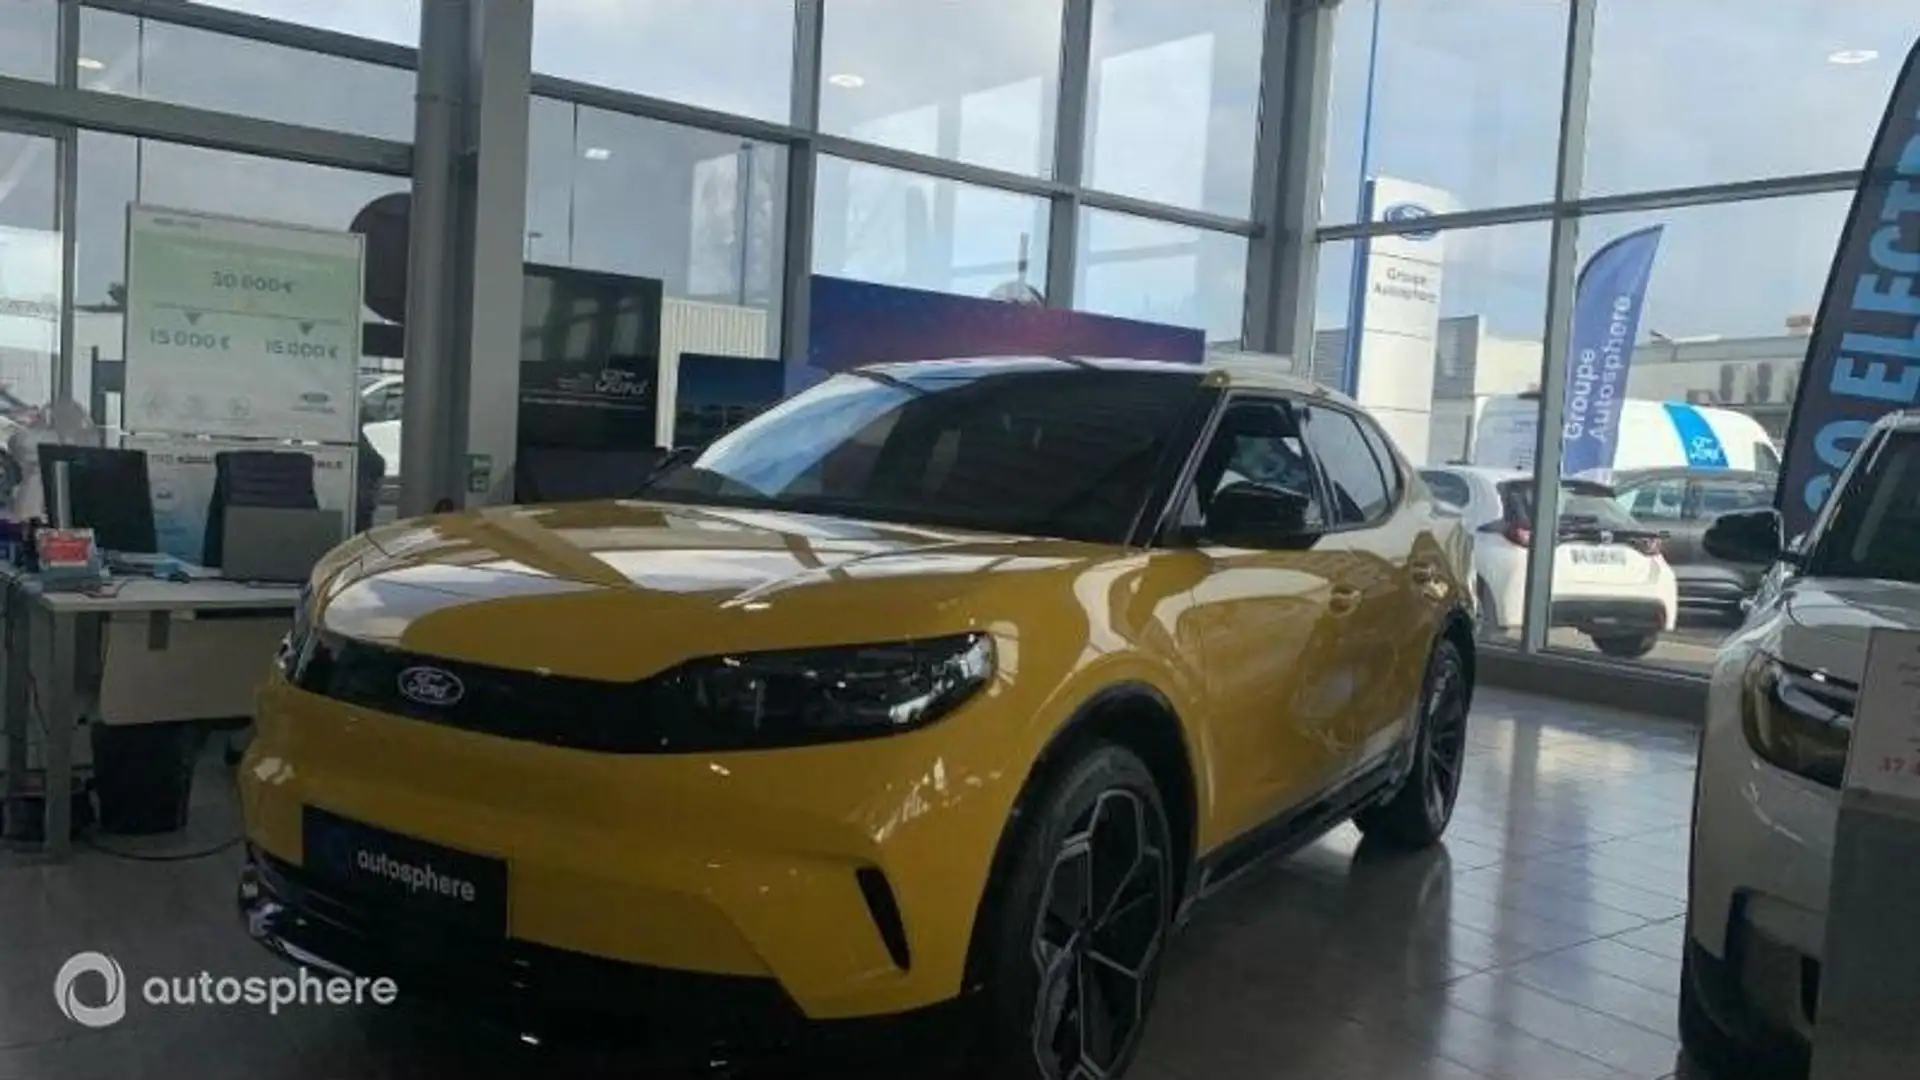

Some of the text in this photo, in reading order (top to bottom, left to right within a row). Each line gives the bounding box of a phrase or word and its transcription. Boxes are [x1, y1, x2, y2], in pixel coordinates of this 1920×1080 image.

[595, 368, 648, 395] Ford
[1564, 348, 1597, 440] Groupe
[405, 670, 455, 699] Ford
[356, 849, 476, 902] autosphere
